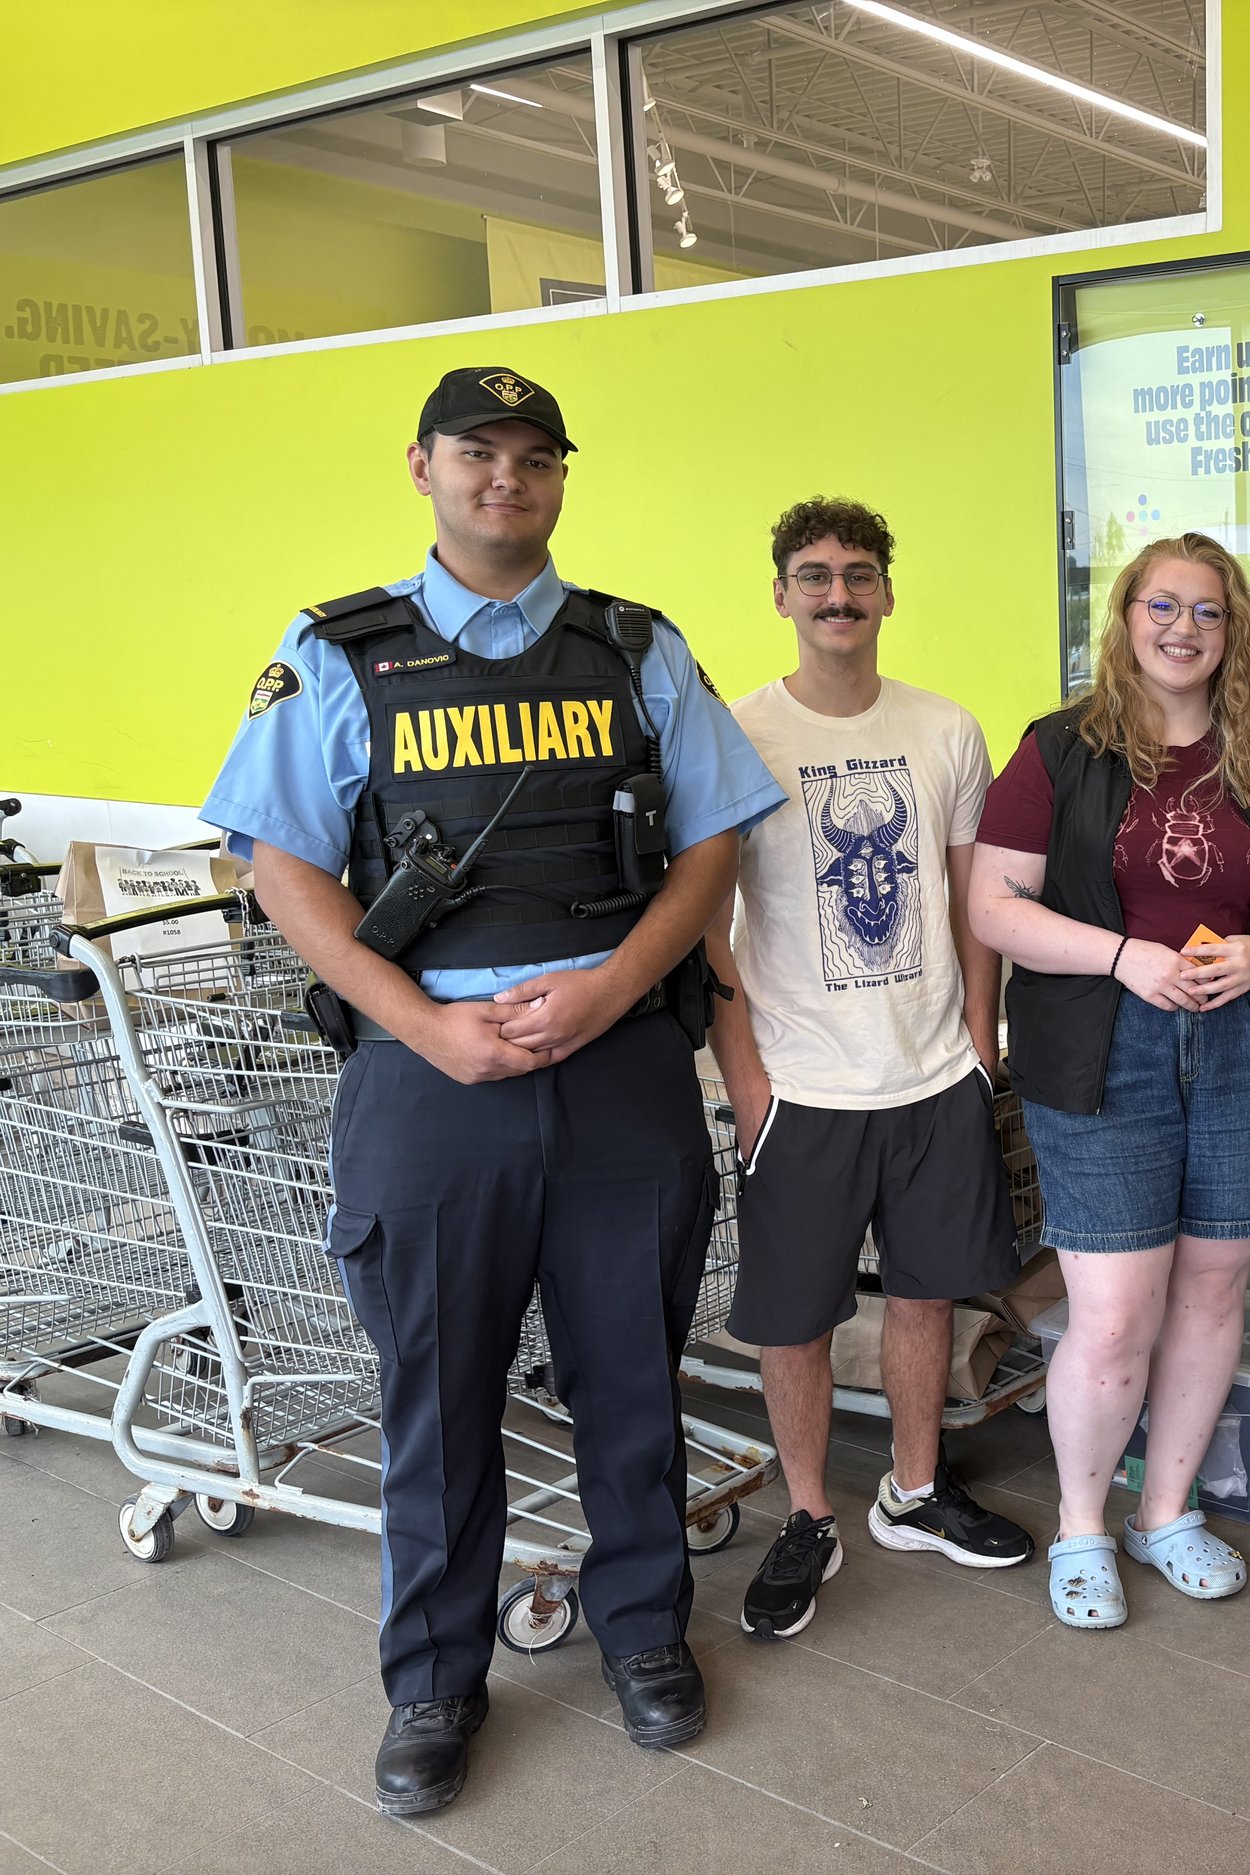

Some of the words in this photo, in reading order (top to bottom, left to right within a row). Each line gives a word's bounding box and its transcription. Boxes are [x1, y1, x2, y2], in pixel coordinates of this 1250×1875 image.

[1176, 343, 1231, 375] Earn
[1132, 382, 1194, 414] more
[1145, 416, 1189, 447] use
[1193, 410, 1235, 442] the
[393, 699, 614, 776] AUXILIARY
[798, 763, 838, 780] King
[846, 755, 908, 773] Gizzard
[645, 809, 657, 826] T
[122, 868, 142, 877] BACK
[825, 982, 849, 993] The
[854, 976, 890, 990] Lizard
[894, 968, 924, 985] Wizard
